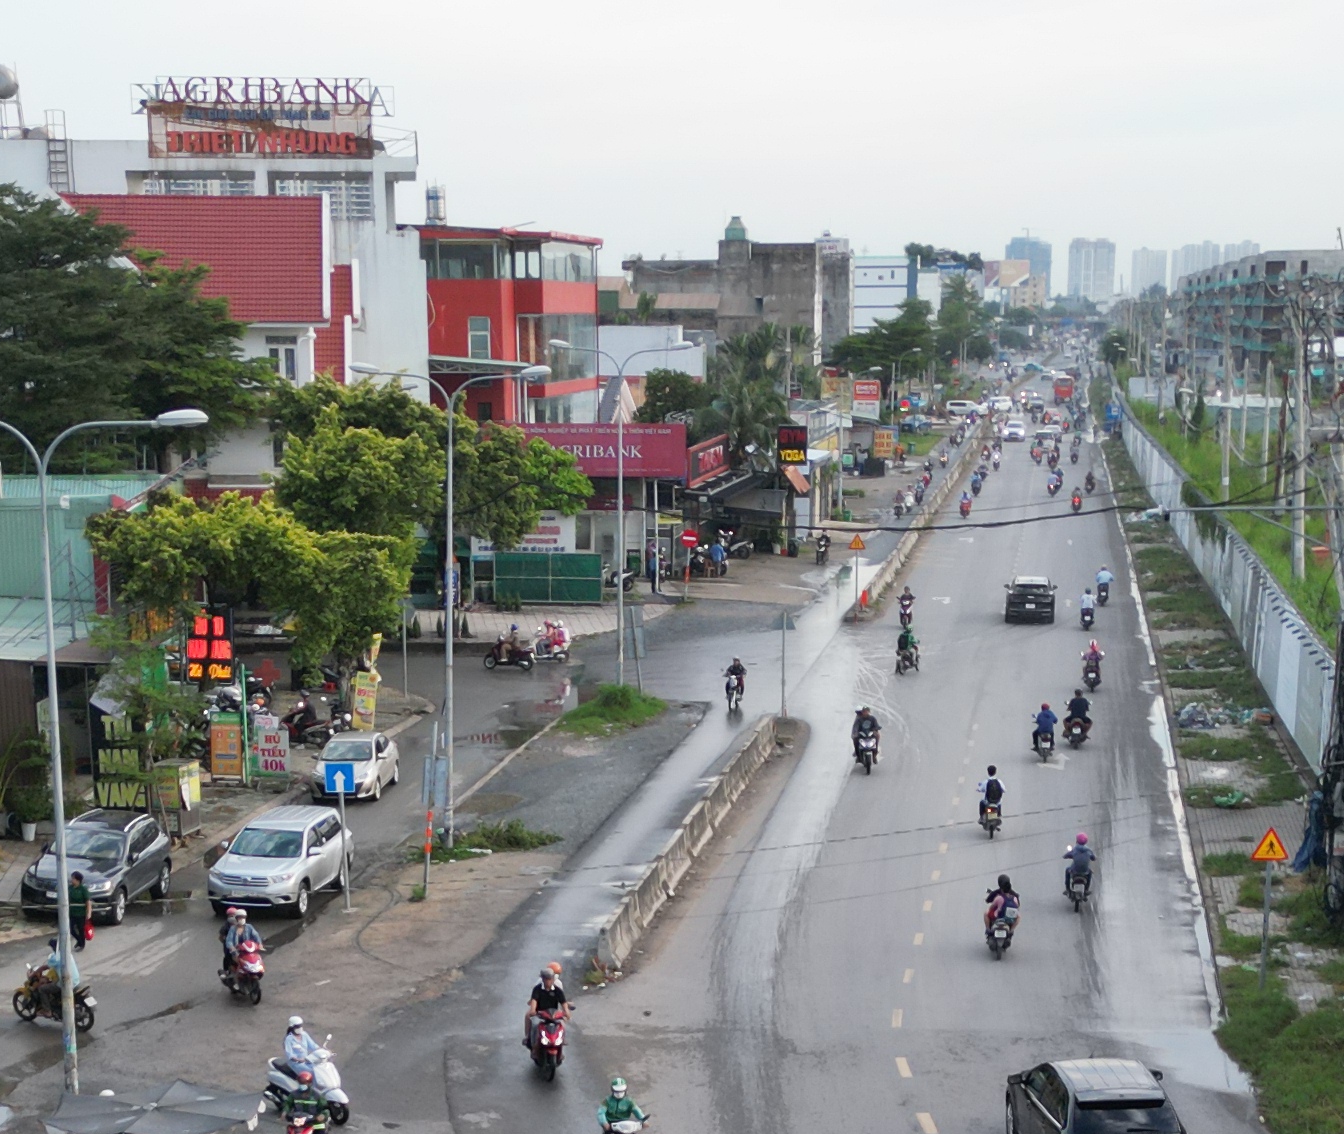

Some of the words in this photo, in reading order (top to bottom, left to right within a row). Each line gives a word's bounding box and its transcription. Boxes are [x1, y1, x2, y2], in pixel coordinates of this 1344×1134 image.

[161, 77, 371, 104] AGRIBANK
[780, 449, 806, 462] YOGA
[260, 745, 286, 758] TIẾU
